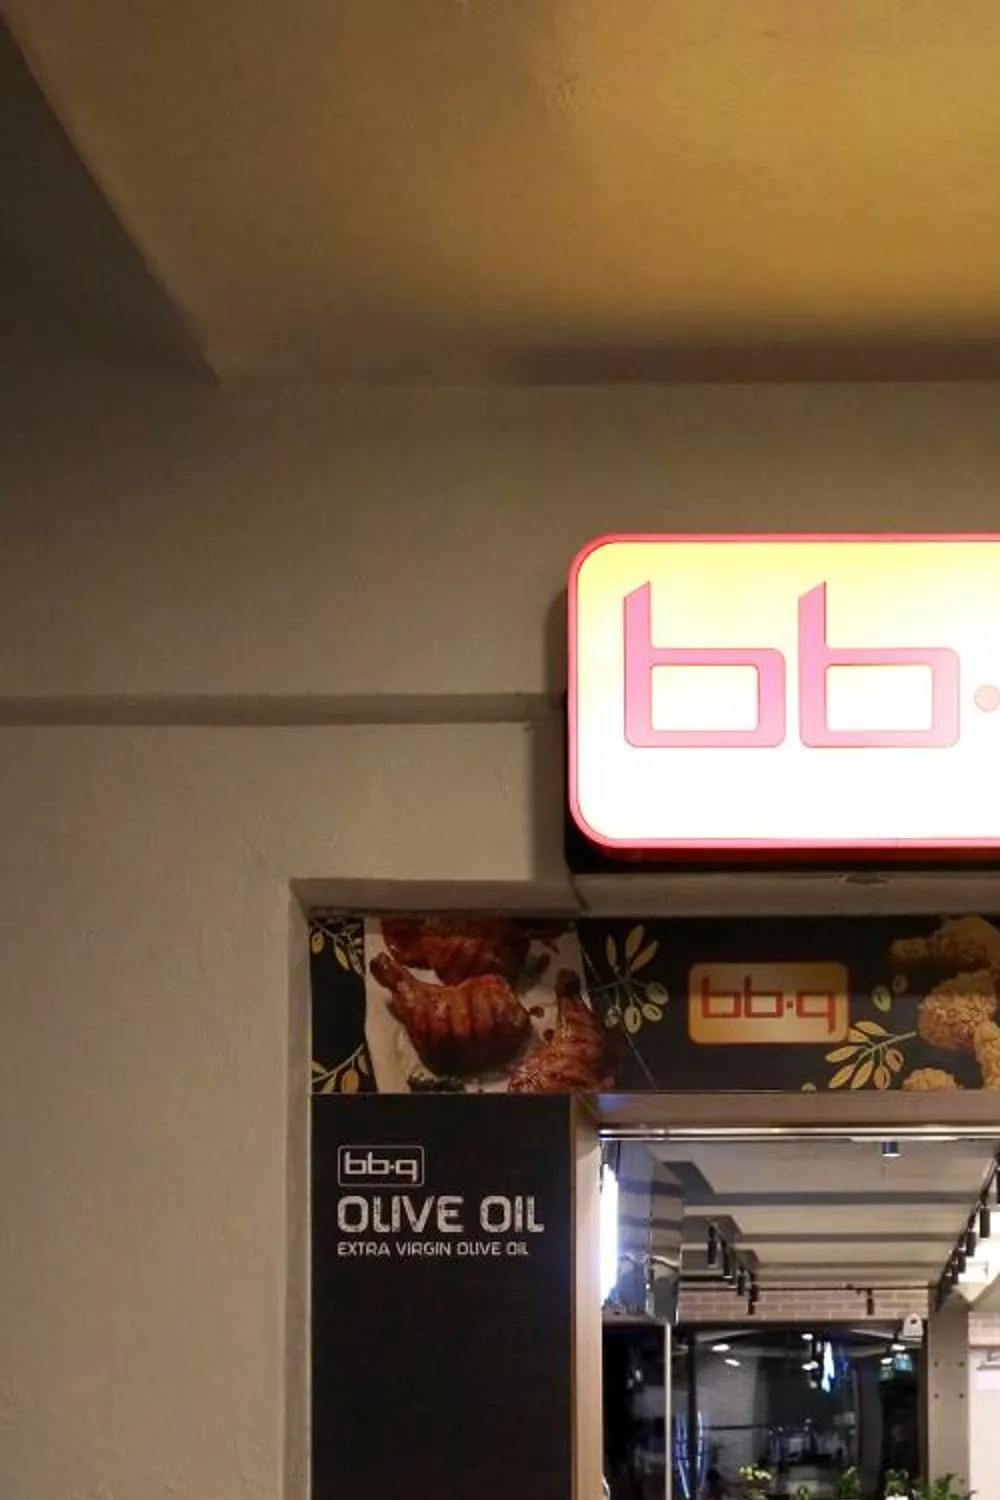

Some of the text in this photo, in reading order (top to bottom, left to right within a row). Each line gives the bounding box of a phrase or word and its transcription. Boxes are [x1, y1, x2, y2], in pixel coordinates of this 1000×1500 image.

[337, 1195, 545, 1233] OLIVE OIL
[337, 1241, 529, 1256] EXTRA VIRGIN OLIVE OIL
